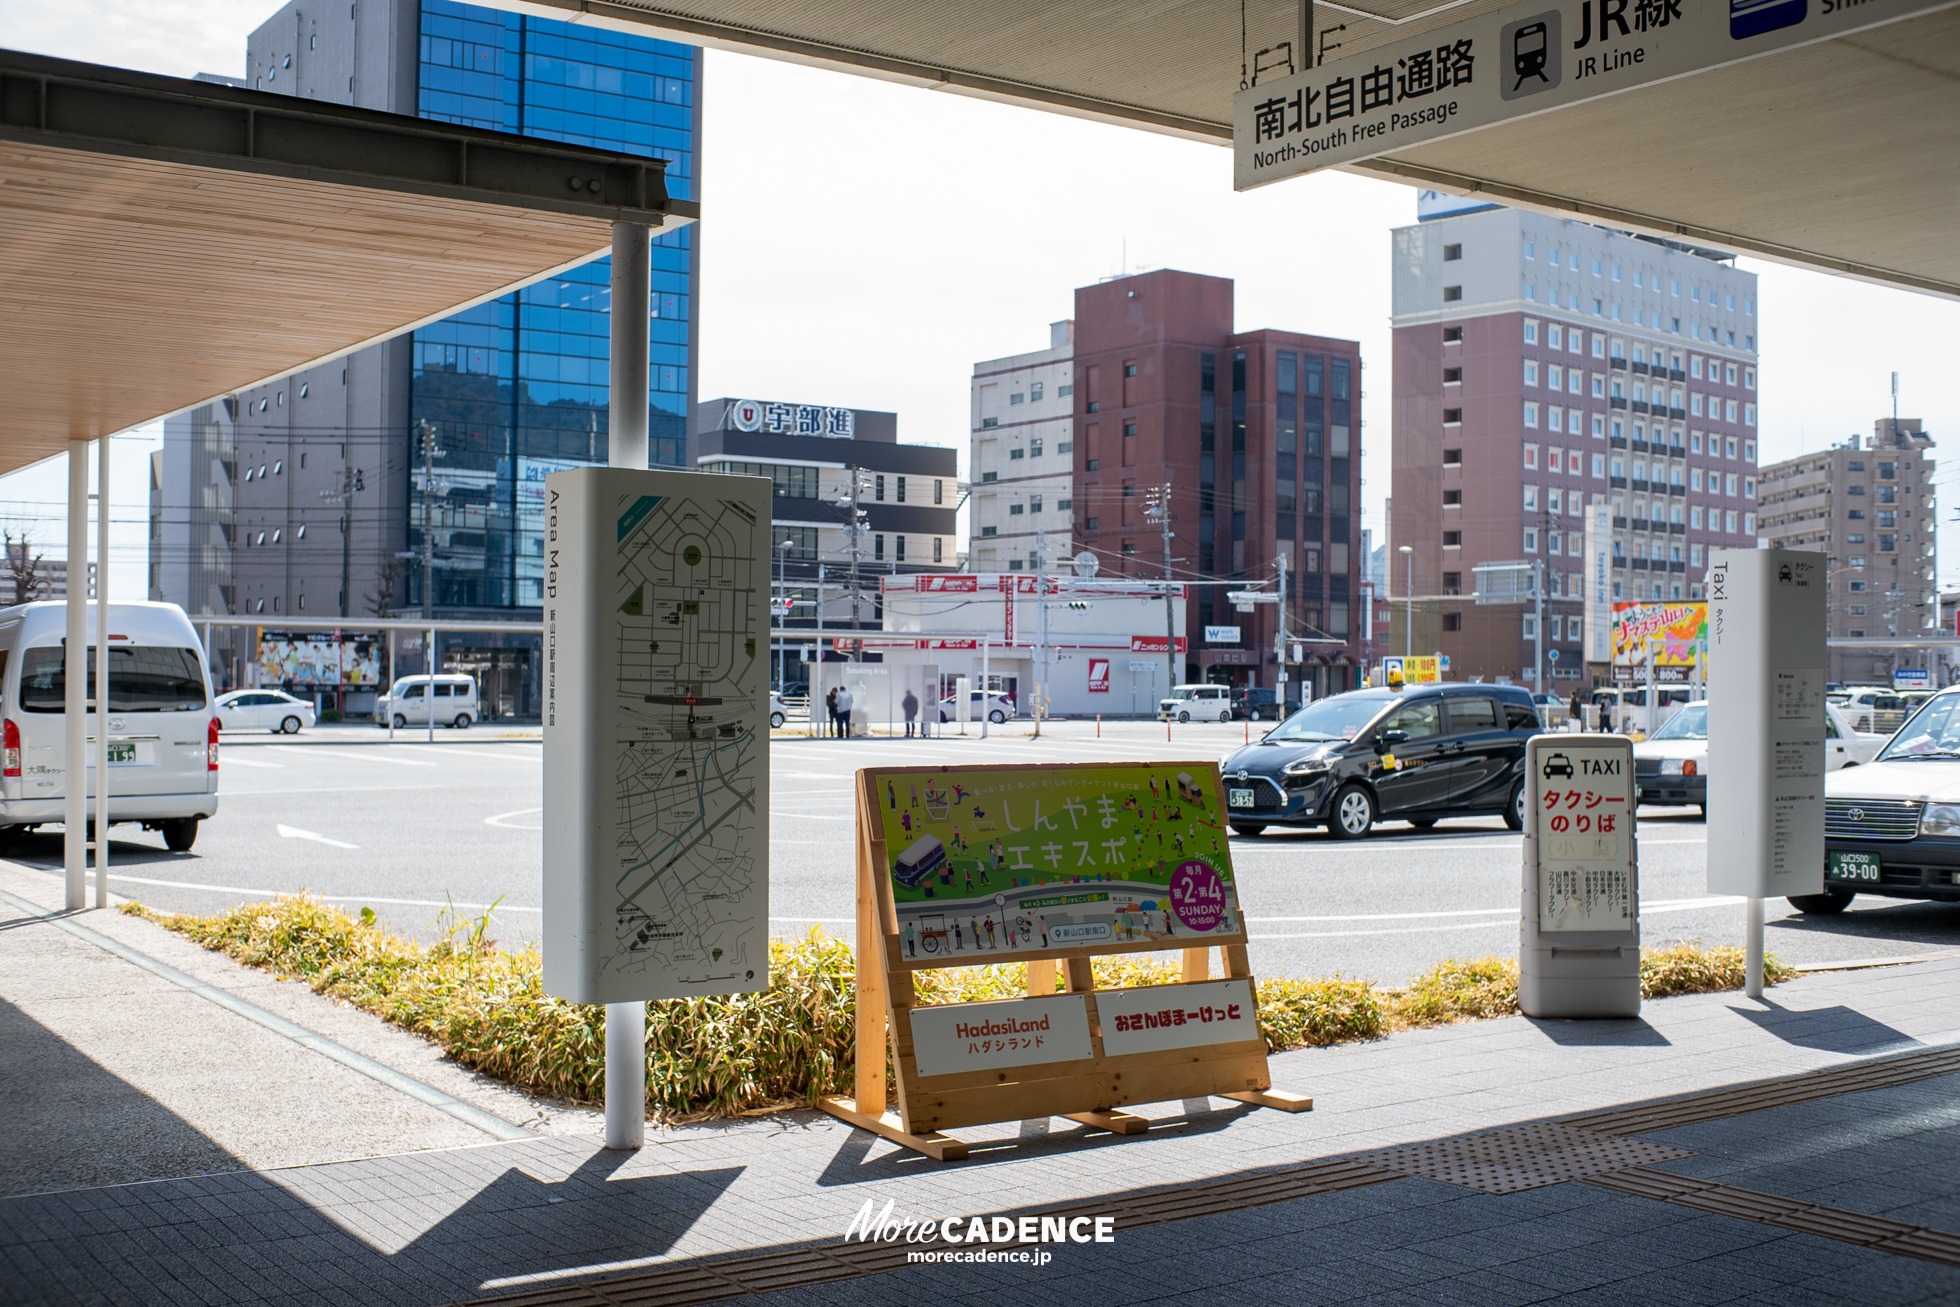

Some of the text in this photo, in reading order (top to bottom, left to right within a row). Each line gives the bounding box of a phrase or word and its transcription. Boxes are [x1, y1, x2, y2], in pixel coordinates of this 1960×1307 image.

[1575, 46, 1646, 81] JR Line
[1253, 38, 1475, 144] 南北自由通路
[1253, 99, 1459, 171] North-South Free Passage
[766, 404, 850, 438] 宇部進
[547, 489, 560, 599] Area Map
[1794, 561, 1815, 571] タクシー
[1713, 561, 1728, 601] Taxi
[1715, 608, 1725, 645] タクシー
[1140, 643, 1182, 651] ニッポンレンカー
[846, 666, 888, 676] Smoking Area
[1580, 759, 1621, 775] TAXI
[1542, 789, 1625, 810] タクシー
[1003, 794, 1120, 832] しんやま
[1551, 814, 1616, 833] のりば
[1008, 837, 1127, 870] エキスポ
[1194, 851, 1214, 866] JOIN
[1185, 865, 1202, 876] 毎月
[1840, 863, 1878, 880] 39-00
[1179, 904, 1221, 916] SUNDAY
[1063, 926, 1106, 938] 新山口駅南口
[956, 1013, 1050, 1039] HadasiLand
[1115, 1003, 1241, 1032] おさんぽまーけっと
[968, 1035, 1044, 1055] ハダシランド
